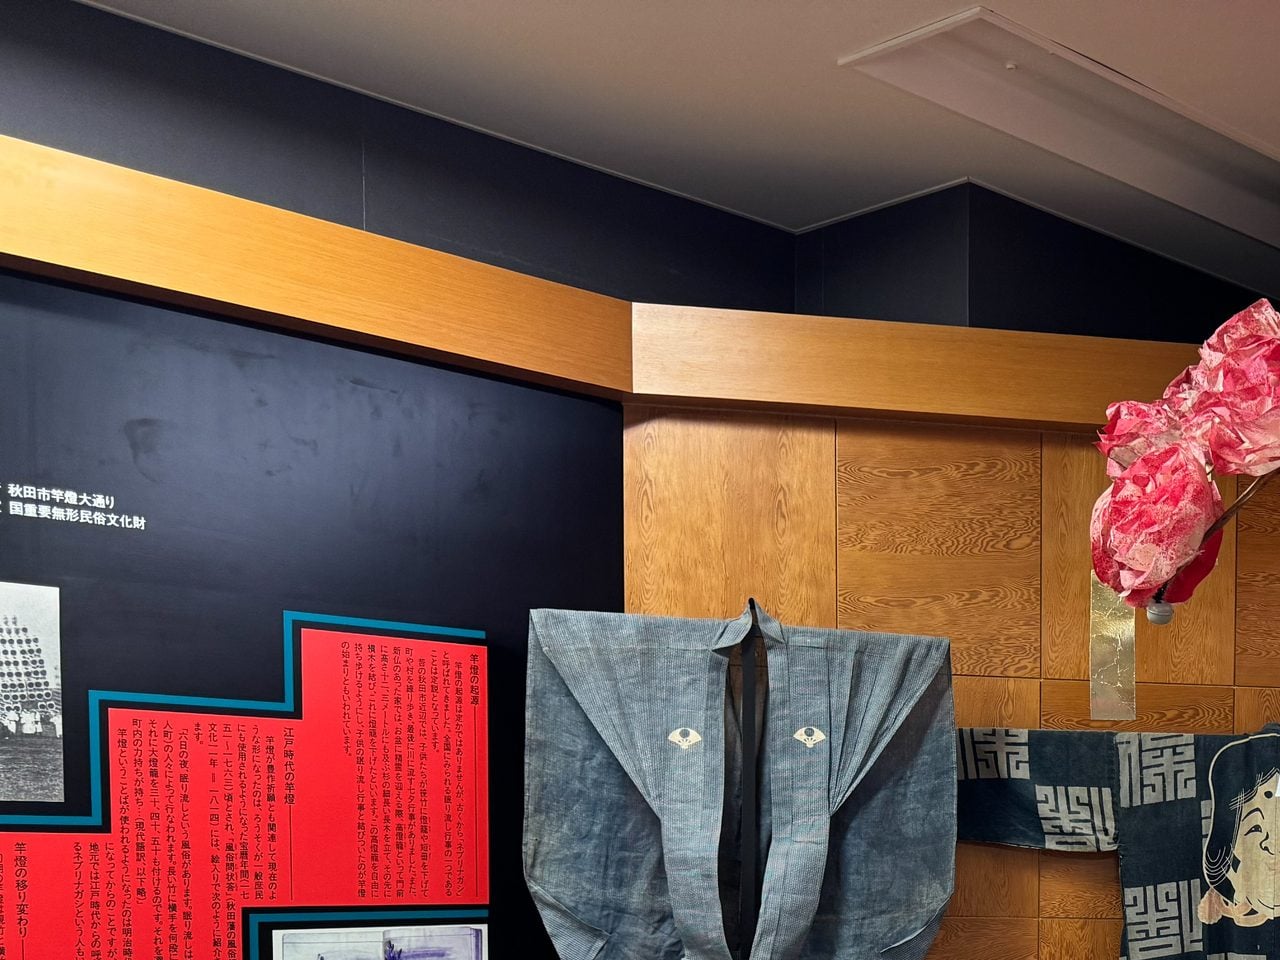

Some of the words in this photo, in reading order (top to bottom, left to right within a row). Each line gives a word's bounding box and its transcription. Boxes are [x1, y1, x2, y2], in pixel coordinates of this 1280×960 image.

[8, 483, 115, 509] 秋田市竿燈大通り
[9, 500, 146, 530] 国重要無形民俗文化財
[470, 653, 479, 705] 竿燈の起源
[194, 722, 204, 745] ます。
[284, 727, 295, 805] 江戸時代の竿燈
[14, 842, 29, 938] 竿燈の移り変わり
